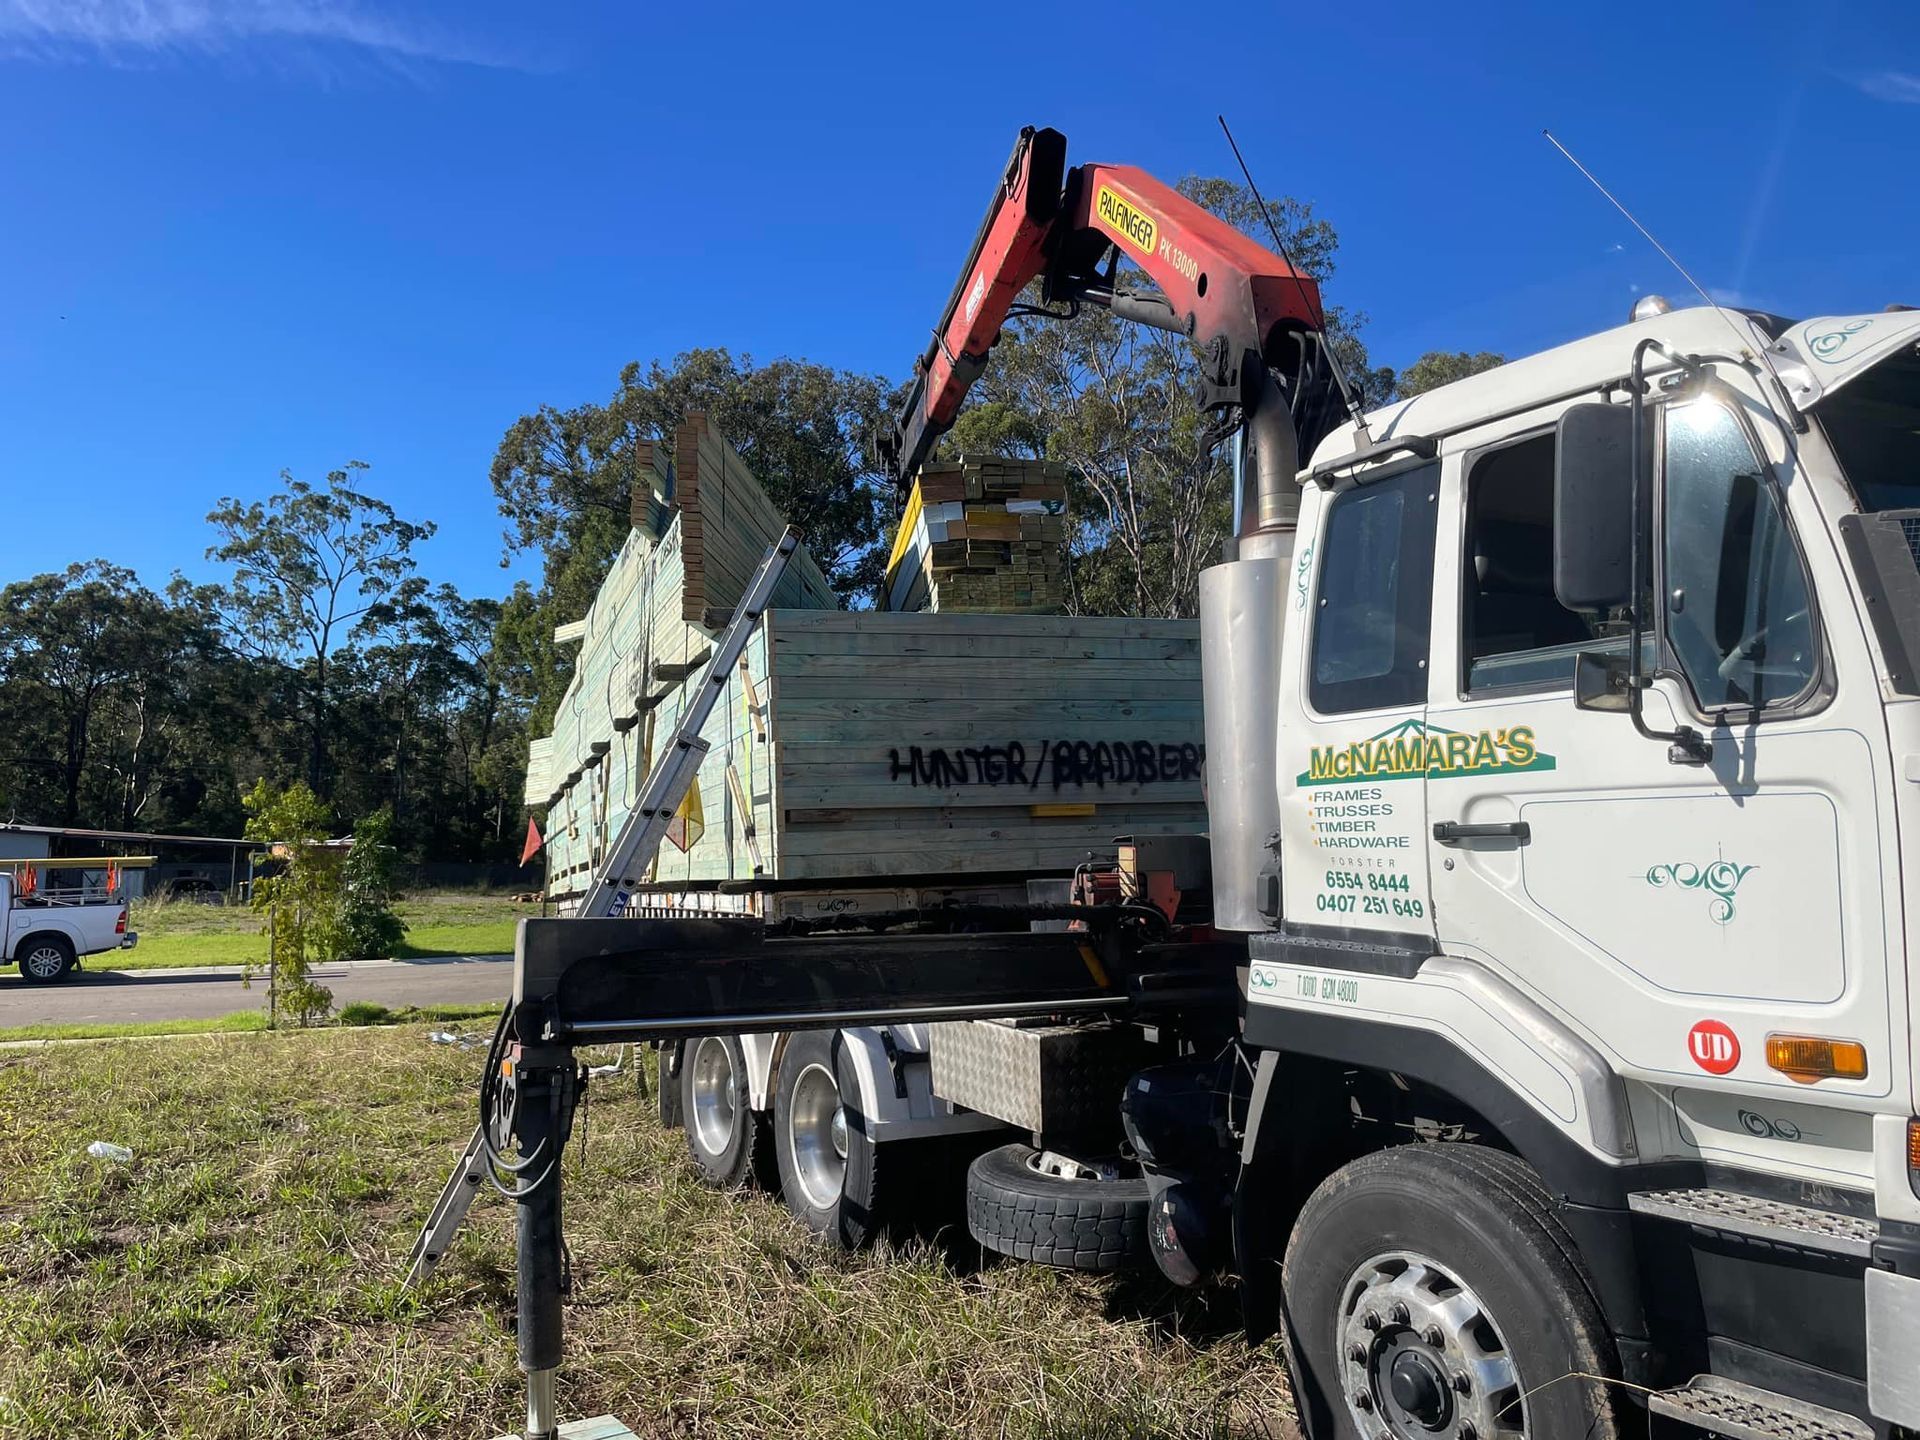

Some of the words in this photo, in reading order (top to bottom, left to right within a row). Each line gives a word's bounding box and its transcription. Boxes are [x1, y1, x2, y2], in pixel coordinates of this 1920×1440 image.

[1098, 190, 1153, 249] PALFINGER
[1159, 236, 1171, 261] PK
[1172, 249, 1198, 282] 13000
[1309, 726, 1536, 779] McNAMARA'S
[889, 739, 1206, 793] HUNTER/BRADBER
[1314, 788, 1382, 802] FRAMES
[1314, 804, 1393, 818] TRUSSES
[1316, 820, 1376, 833] TIMBER
[1319, 836, 1410, 849] HARDWARE
[1331, 856, 1395, 868] FORSTER
[1326, 871, 1363, 890] 6554
[1369, 872, 1410, 892] 8444
[1316, 894, 1357, 913] 0407
[1363, 896, 1390, 915] 251
[1392, 898, 1424, 918] 649
[1692, 1031, 1732, 1061] UD
